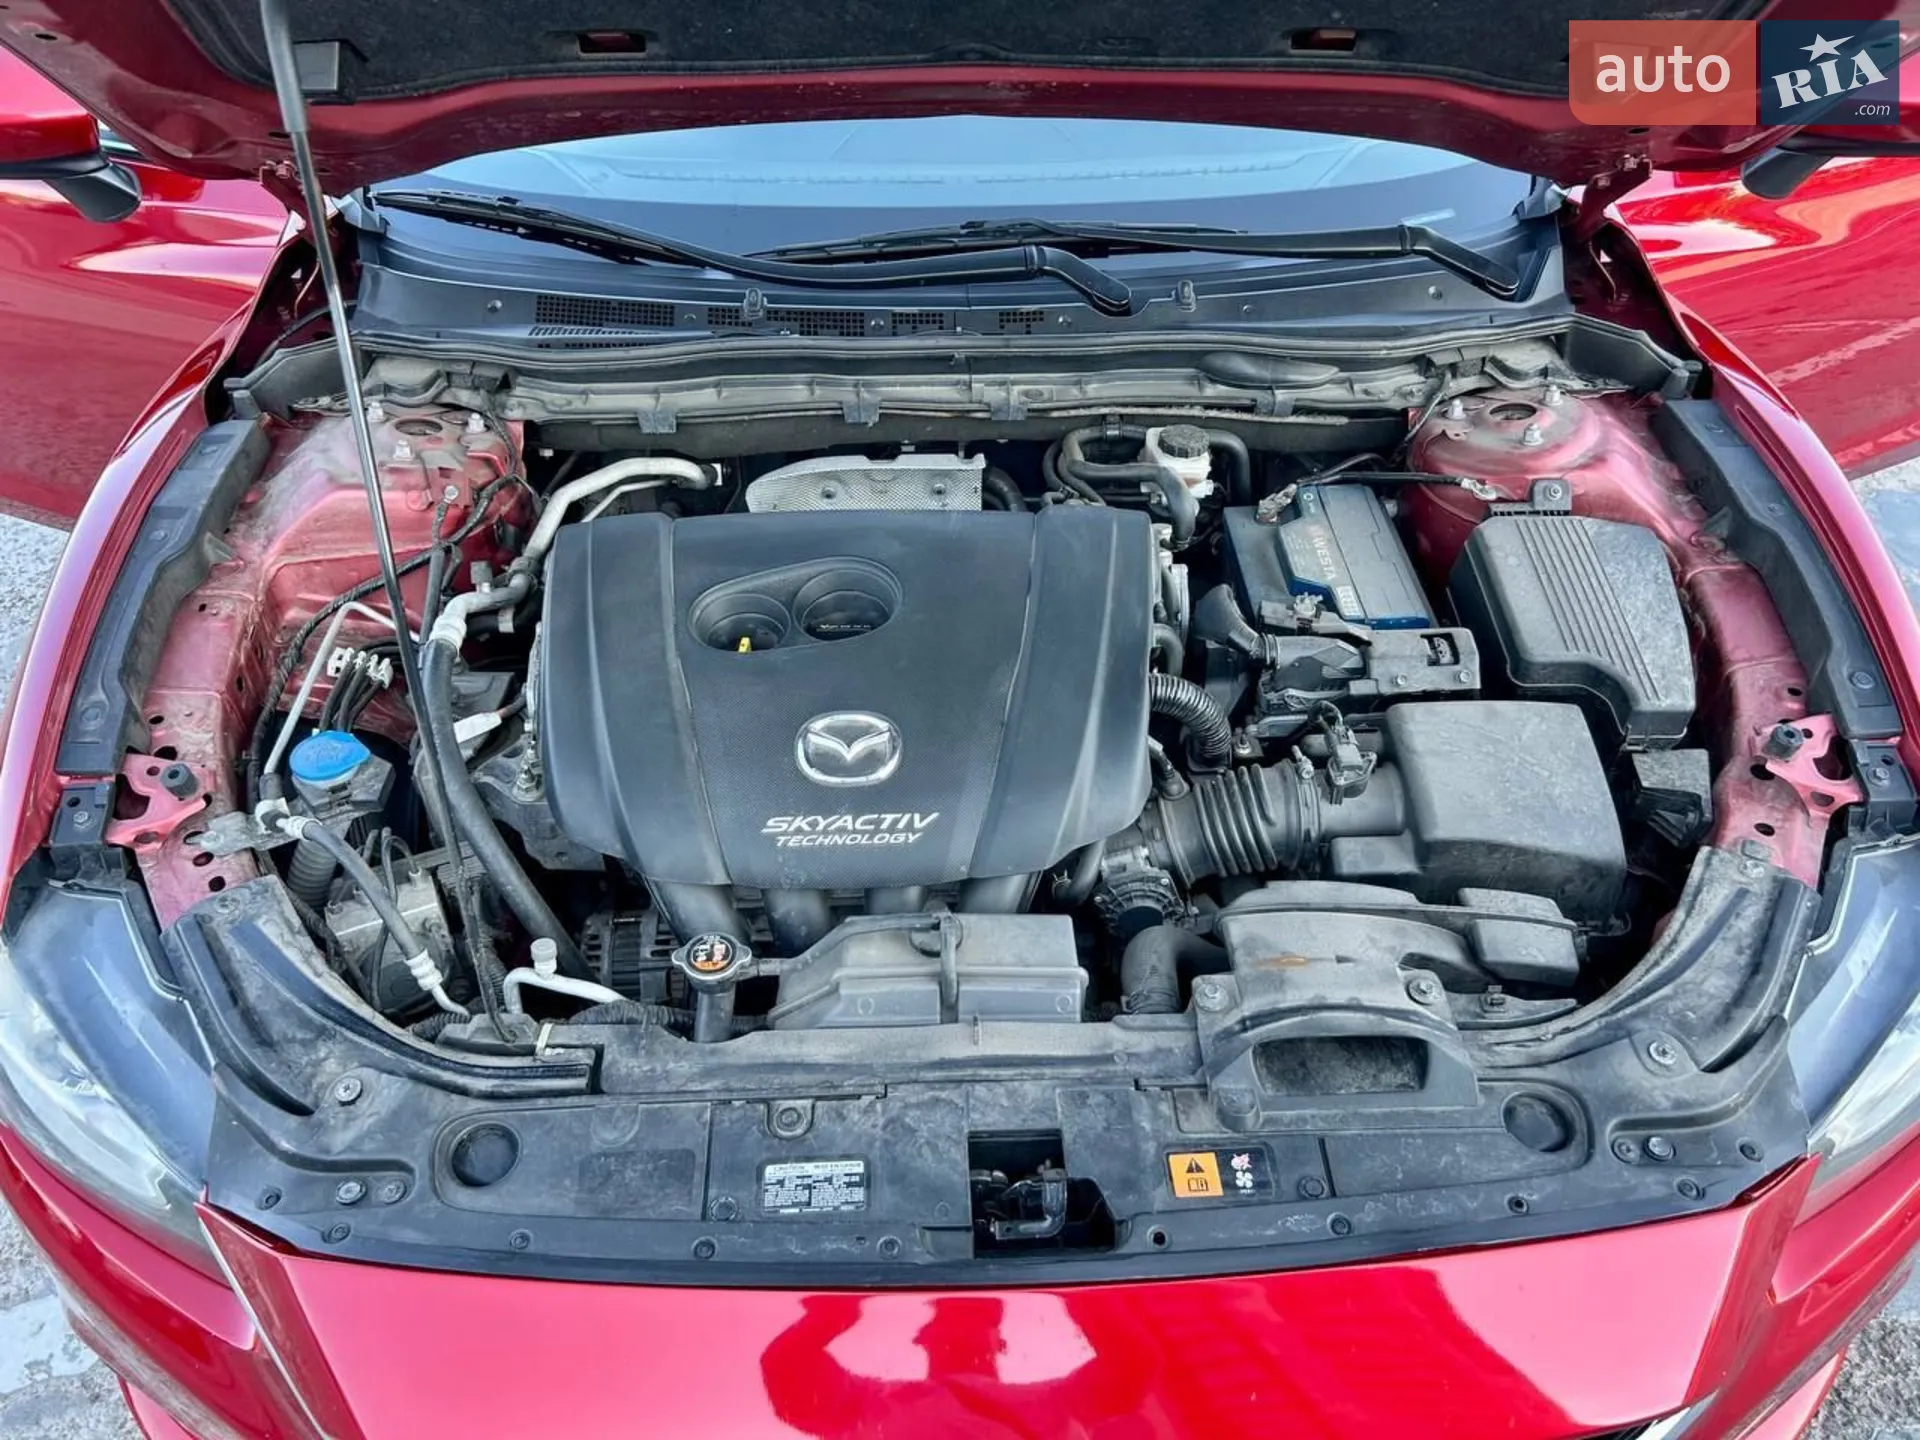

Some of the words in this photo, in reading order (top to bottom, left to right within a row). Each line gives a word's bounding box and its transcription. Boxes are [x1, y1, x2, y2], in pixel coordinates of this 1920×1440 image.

[1312, 537, 1337, 580] WESTA
[761, 812, 940, 833] SKYACTIV
[775, 832, 923, 847] TECHNOLOGY
